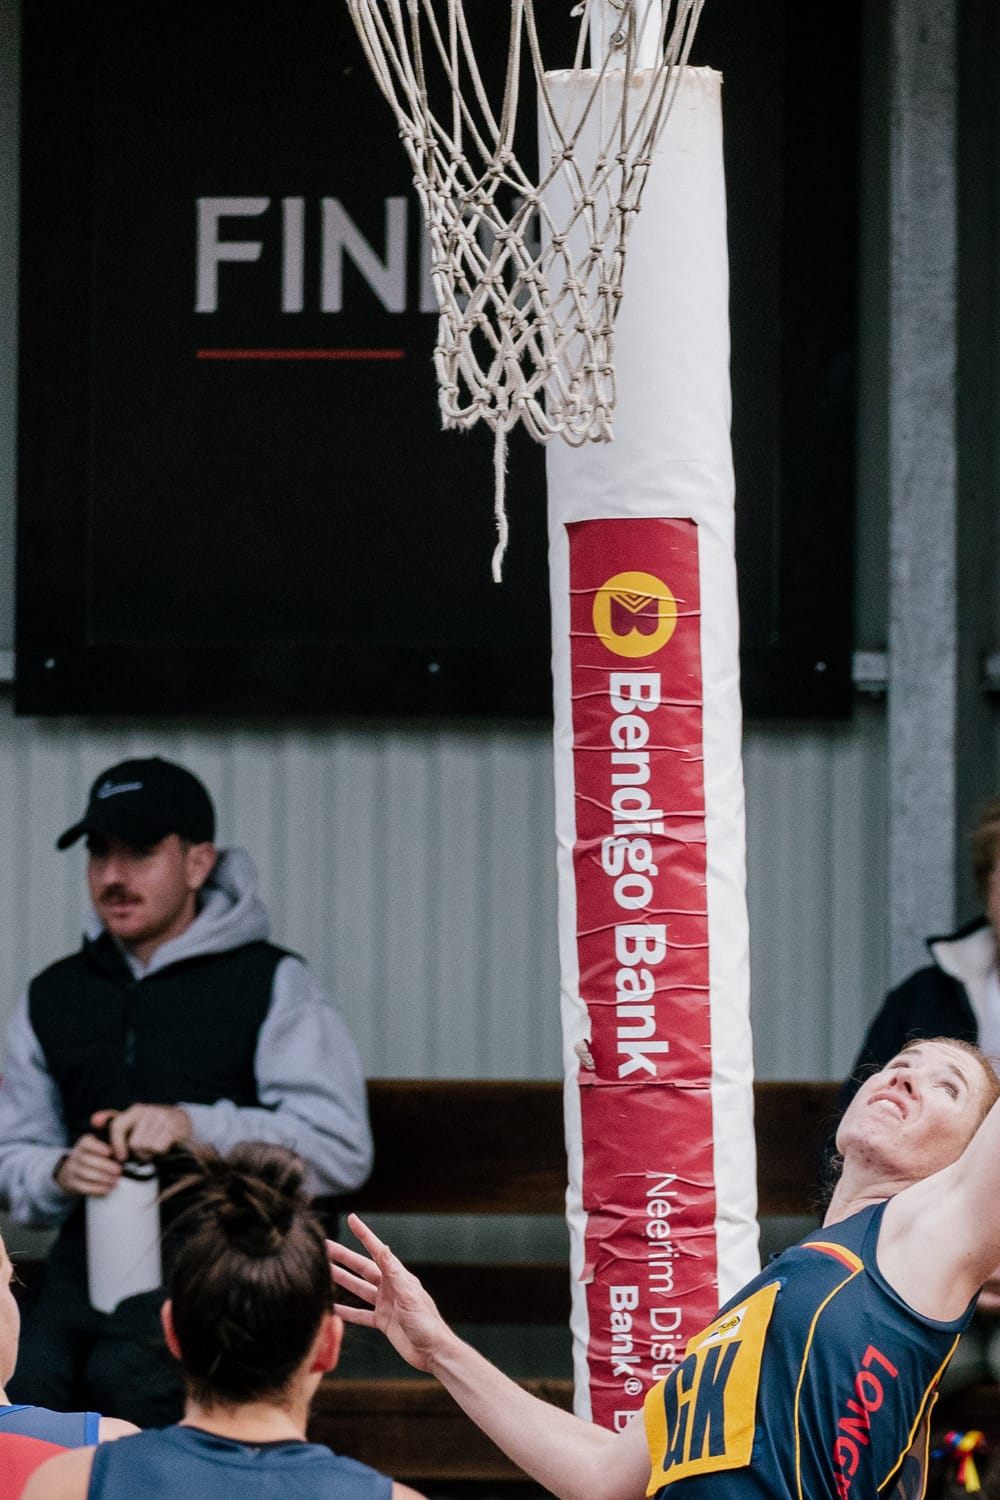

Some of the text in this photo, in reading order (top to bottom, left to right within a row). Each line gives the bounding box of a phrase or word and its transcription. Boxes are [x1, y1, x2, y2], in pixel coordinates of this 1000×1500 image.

[602, 672, 670, 1078] Bendigo Bank
[646, 1172, 678, 1294] Neerim
[663, 1340, 743, 1472] GK
